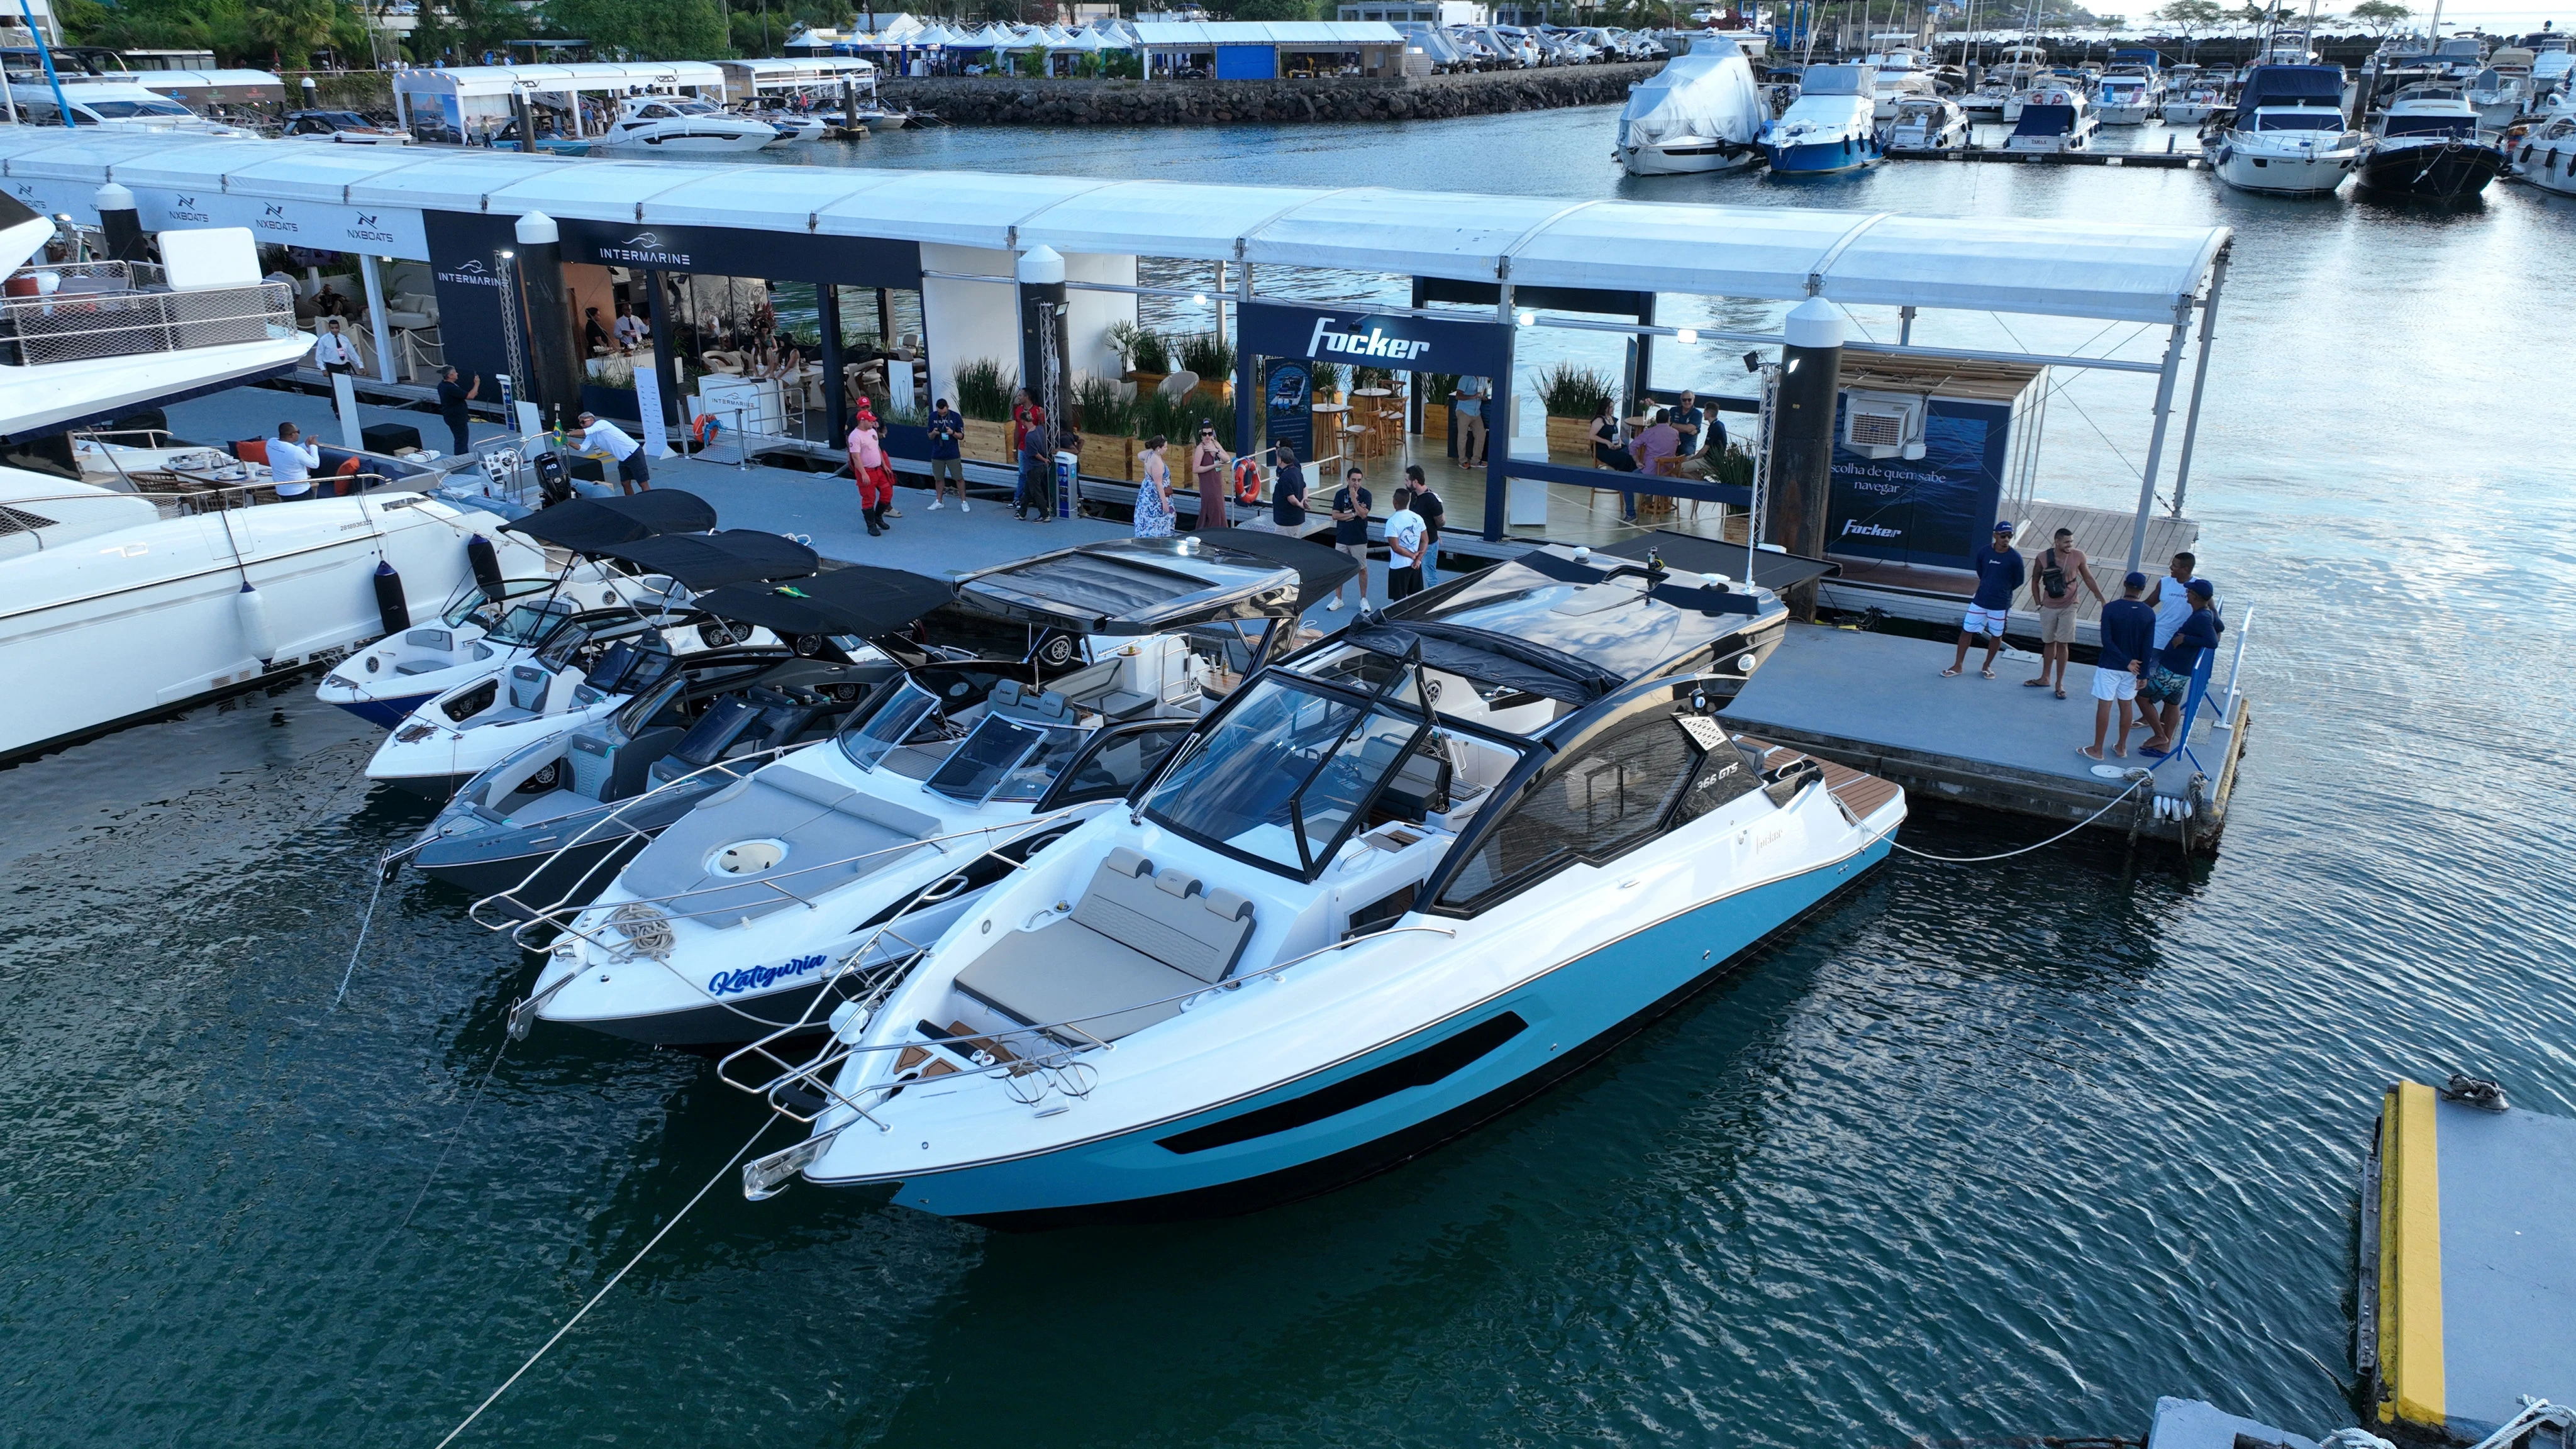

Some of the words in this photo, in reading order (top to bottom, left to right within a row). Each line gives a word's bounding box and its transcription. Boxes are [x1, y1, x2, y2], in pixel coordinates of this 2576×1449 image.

[169, 211, 209, 222] NXBOATS
[256, 219, 298, 232] NXBOATS
[347, 230, 394, 243] NXBOATS
[599, 248, 691, 265] INTERMARINE
[1306, 316, 1431, 360] Focker
[1831, 463, 1865, 475] scolha
[1867, 465, 1882, 477] de
[1884, 469, 1917, 481] quem
[1918, 471, 1946, 484] sabe
[1855, 481, 1901, 496] navegar
[1841, 519, 1902, 538] Focker
[1696, 774, 1717, 792] 366
[1718, 762, 1739, 780] GTS
[708, 955, 828, 996] Katiguria
